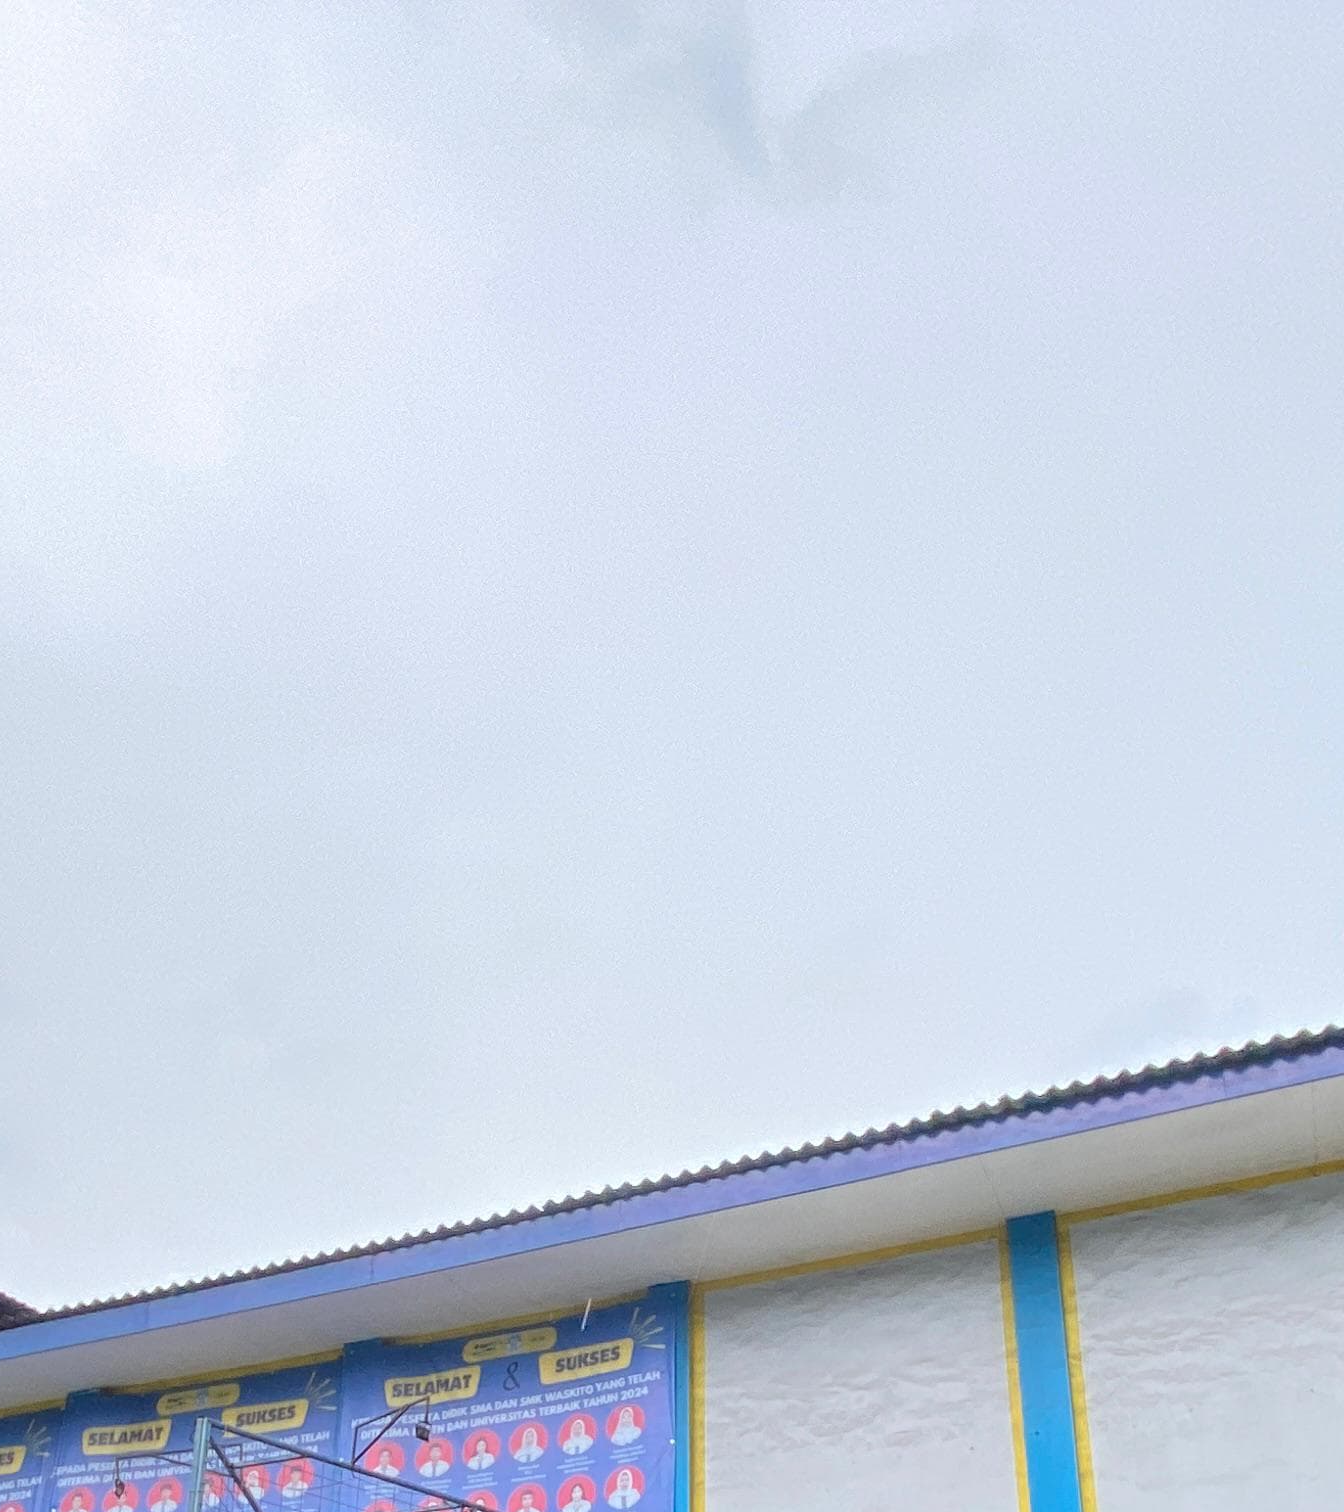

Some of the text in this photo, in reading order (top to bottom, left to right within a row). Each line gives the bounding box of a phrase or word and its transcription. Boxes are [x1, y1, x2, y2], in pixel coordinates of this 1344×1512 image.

[392, 1346, 621, 1398] SELAMAT & SUKSES
[470, 1402, 494, 1415] SMA
[494, 1398, 518, 1411] DAN
[520, 1394, 544, 1407] SMK
[545, 1384, 594, 1402] WASKITO
[595, 1377, 626, 1391] YANG
[628, 1371, 662, 1385] TELAH
[88, 1404, 296, 1446] SELAMAT SUKSES
[470, 1408, 537, 1430] UNIVERSITAS
[539, 1402, 582, 1417] TERBAIK
[583, 1393, 619, 1408] TAHUN
[620, 1386, 649, 1401] 2024
